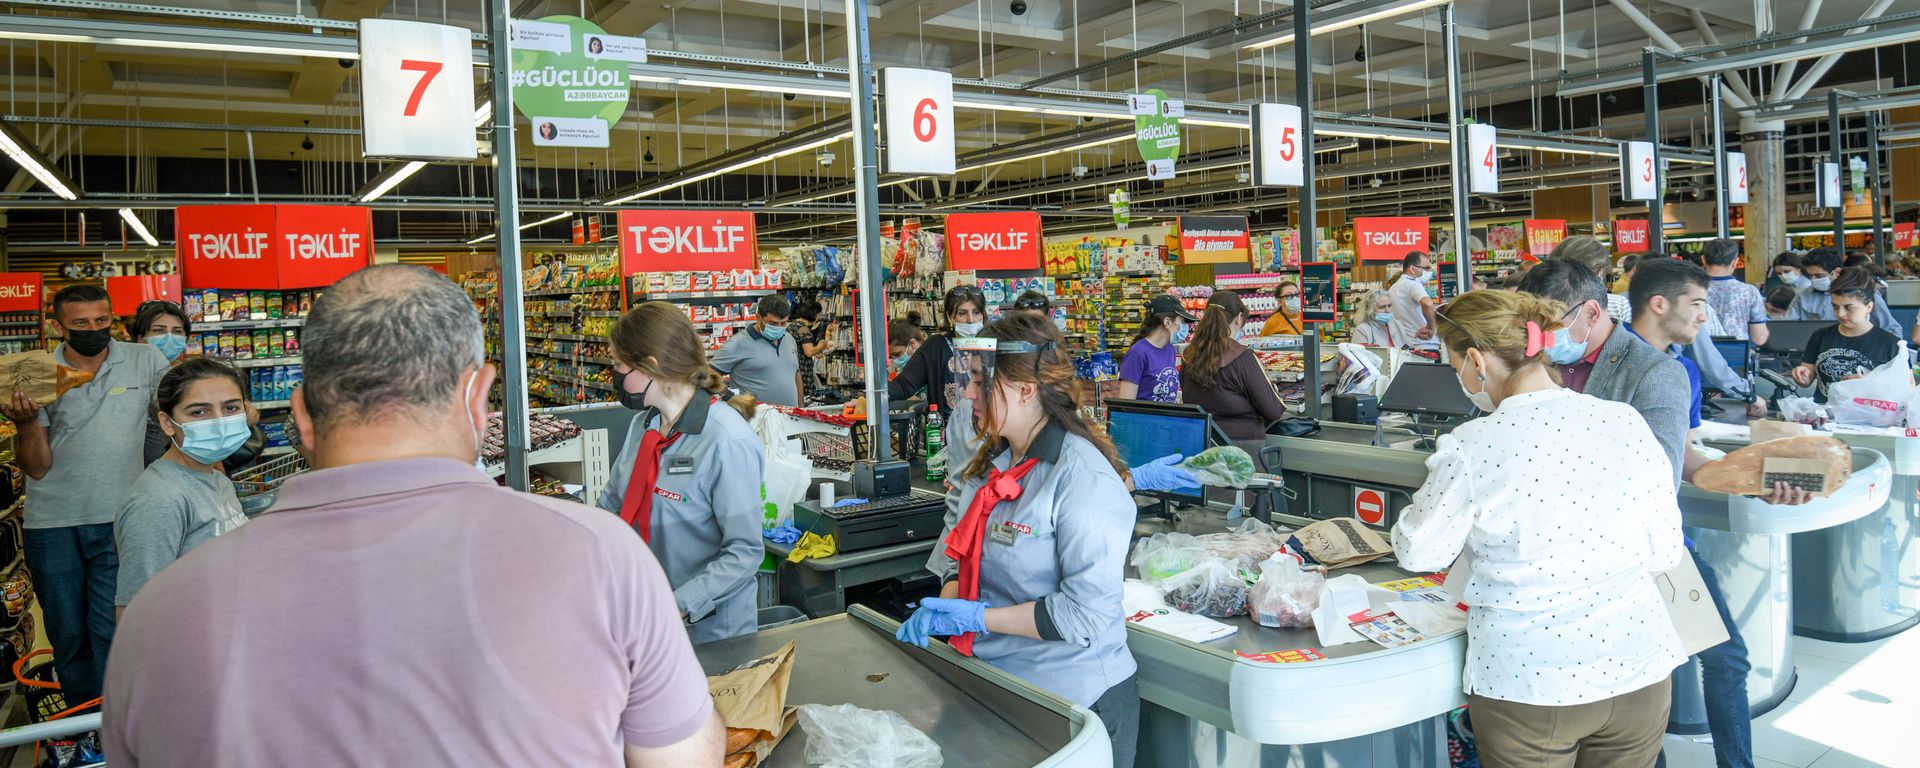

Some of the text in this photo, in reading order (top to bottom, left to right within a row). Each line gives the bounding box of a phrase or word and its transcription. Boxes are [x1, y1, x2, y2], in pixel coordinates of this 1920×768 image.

[511, 66, 625, 87] #GÜCLÜOL
[400, 60, 443, 117] 7
[567, 91, 626, 99] AZƏRBAYCAN
[913, 97, 938, 142] 6
[1137, 123, 1179, 141] #GÜCLÜOL
[1280, 127, 1295, 162] 5
[1483, 144, 1494, 174] 4
[1643, 157, 1652, 183] 3
[1738, 167, 1746, 189] 2
[1833, 175, 1839, 195] 1
[188, 227, 269, 260] TƏKLİF
[285, 228, 360, 260] TƏKLİF
[628, 218, 745, 254] TƏKLİF
[956, 228, 1029, 252] TƏKLİF
[1363, 228, 1422, 247] TƏKLİF
[1618, 226, 1646, 244] TƏKLİF
[0, 282, 36, 298] ƏKLİF
[1862, 399, 1897, 411] SPAR
[657, 489, 681, 502] SPAR
